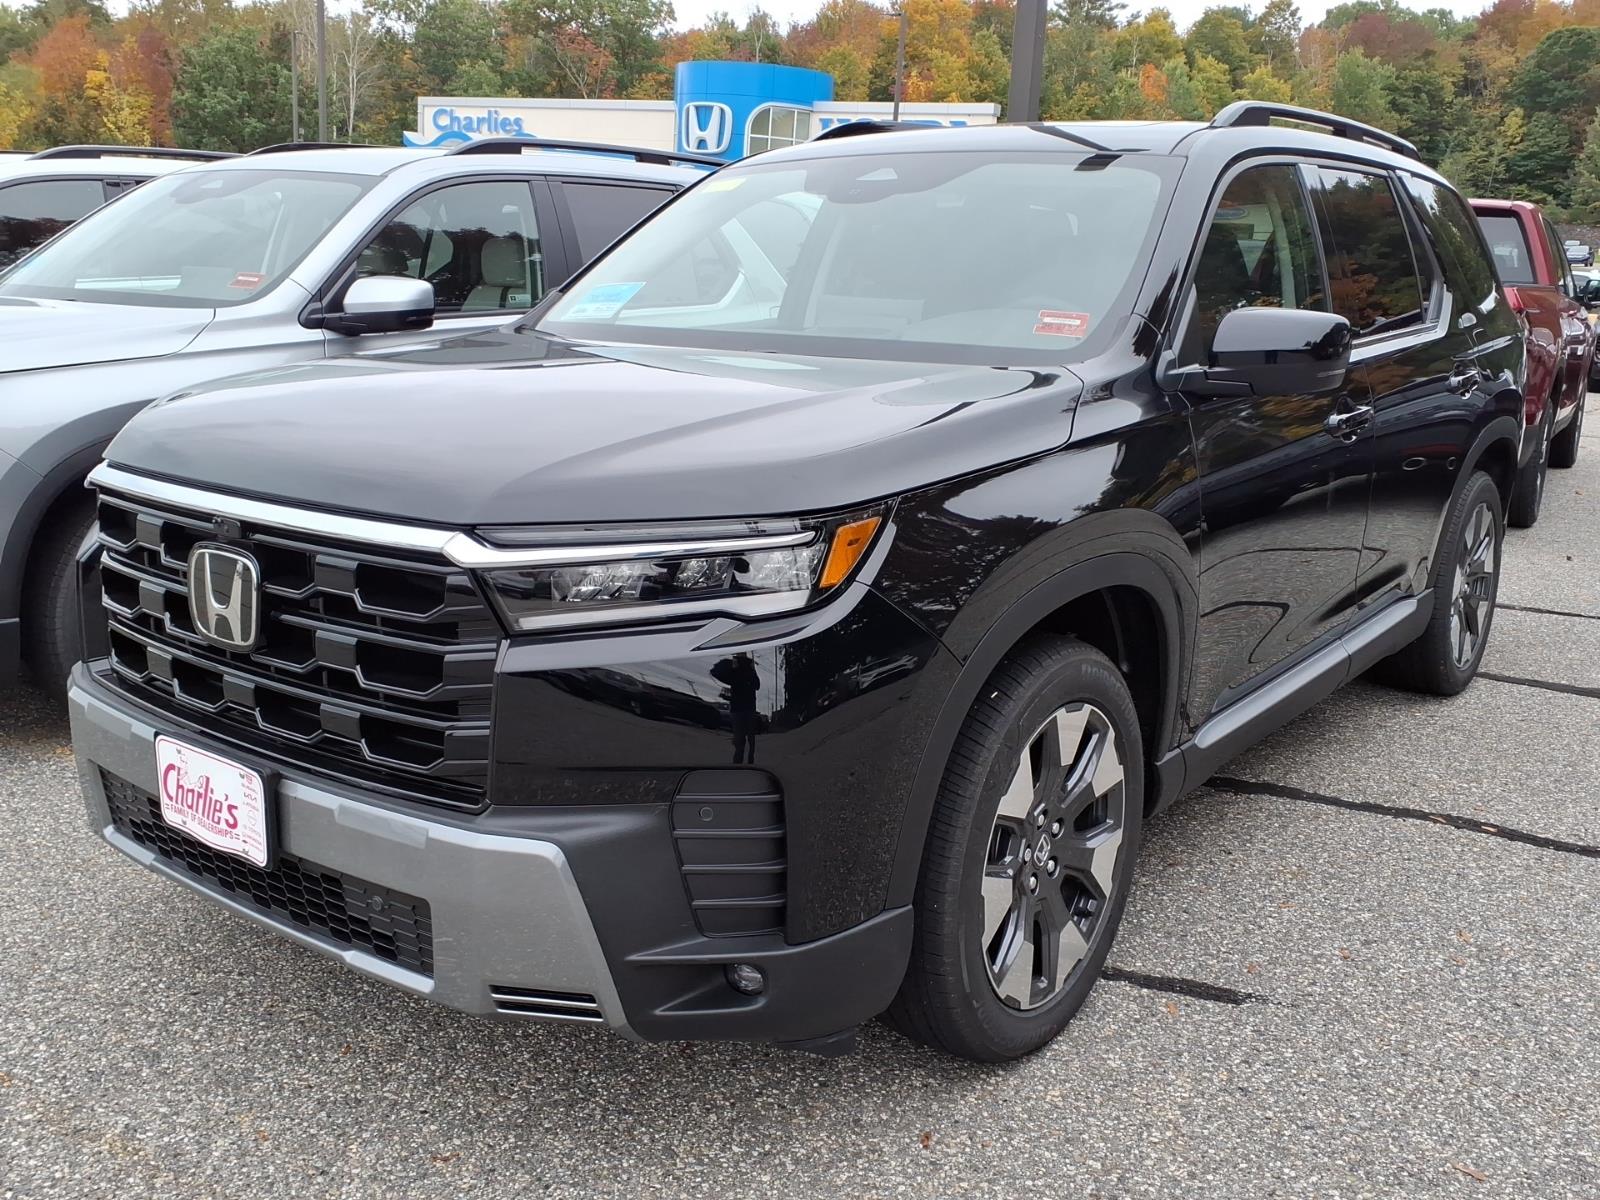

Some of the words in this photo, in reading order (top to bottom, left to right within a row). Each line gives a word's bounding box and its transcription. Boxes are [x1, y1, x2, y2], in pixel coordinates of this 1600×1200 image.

[432, 108, 523, 134] Charlies
[163, 763, 238, 830] Charlie's
[170, 803, 189, 818] FAMILY
[191, 812, 197, 822] OF
[198, 816, 234, 840] DEALERSHIPS
